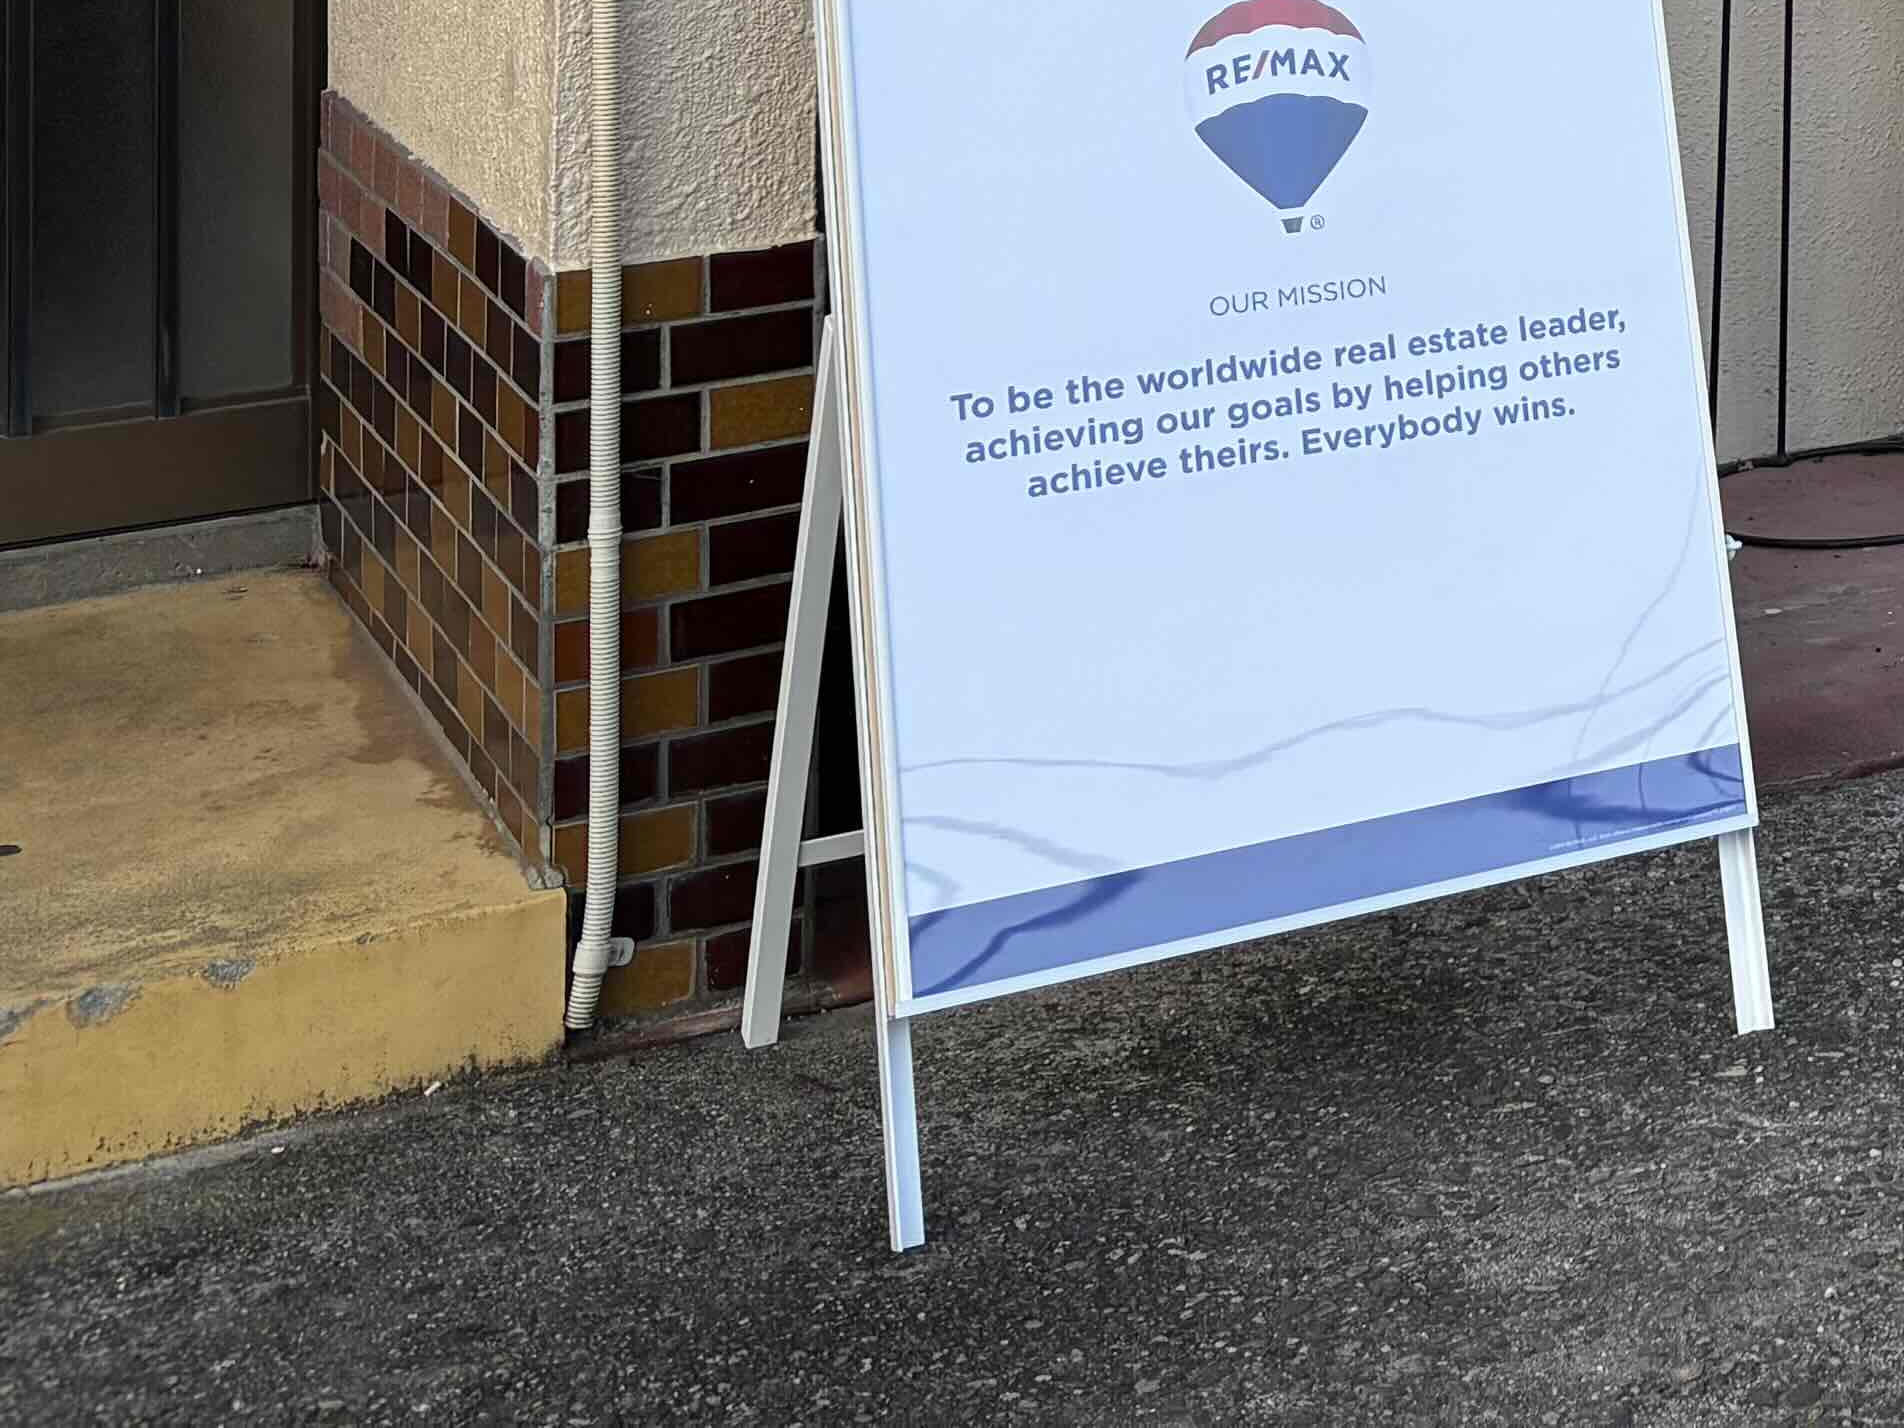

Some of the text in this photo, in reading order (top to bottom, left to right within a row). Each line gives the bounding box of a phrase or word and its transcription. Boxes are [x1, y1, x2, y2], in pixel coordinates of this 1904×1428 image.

[1206, 47, 1351, 95] RE/MAX
[1209, 276, 1387, 316] OUR MISSION
[950, 307, 1627, 420] To be the worldwide real estate leader,
[965, 347, 1621, 463] achieving our goals by helping others
[1027, 395, 1576, 498] achieve theirs. Everybody wins.
